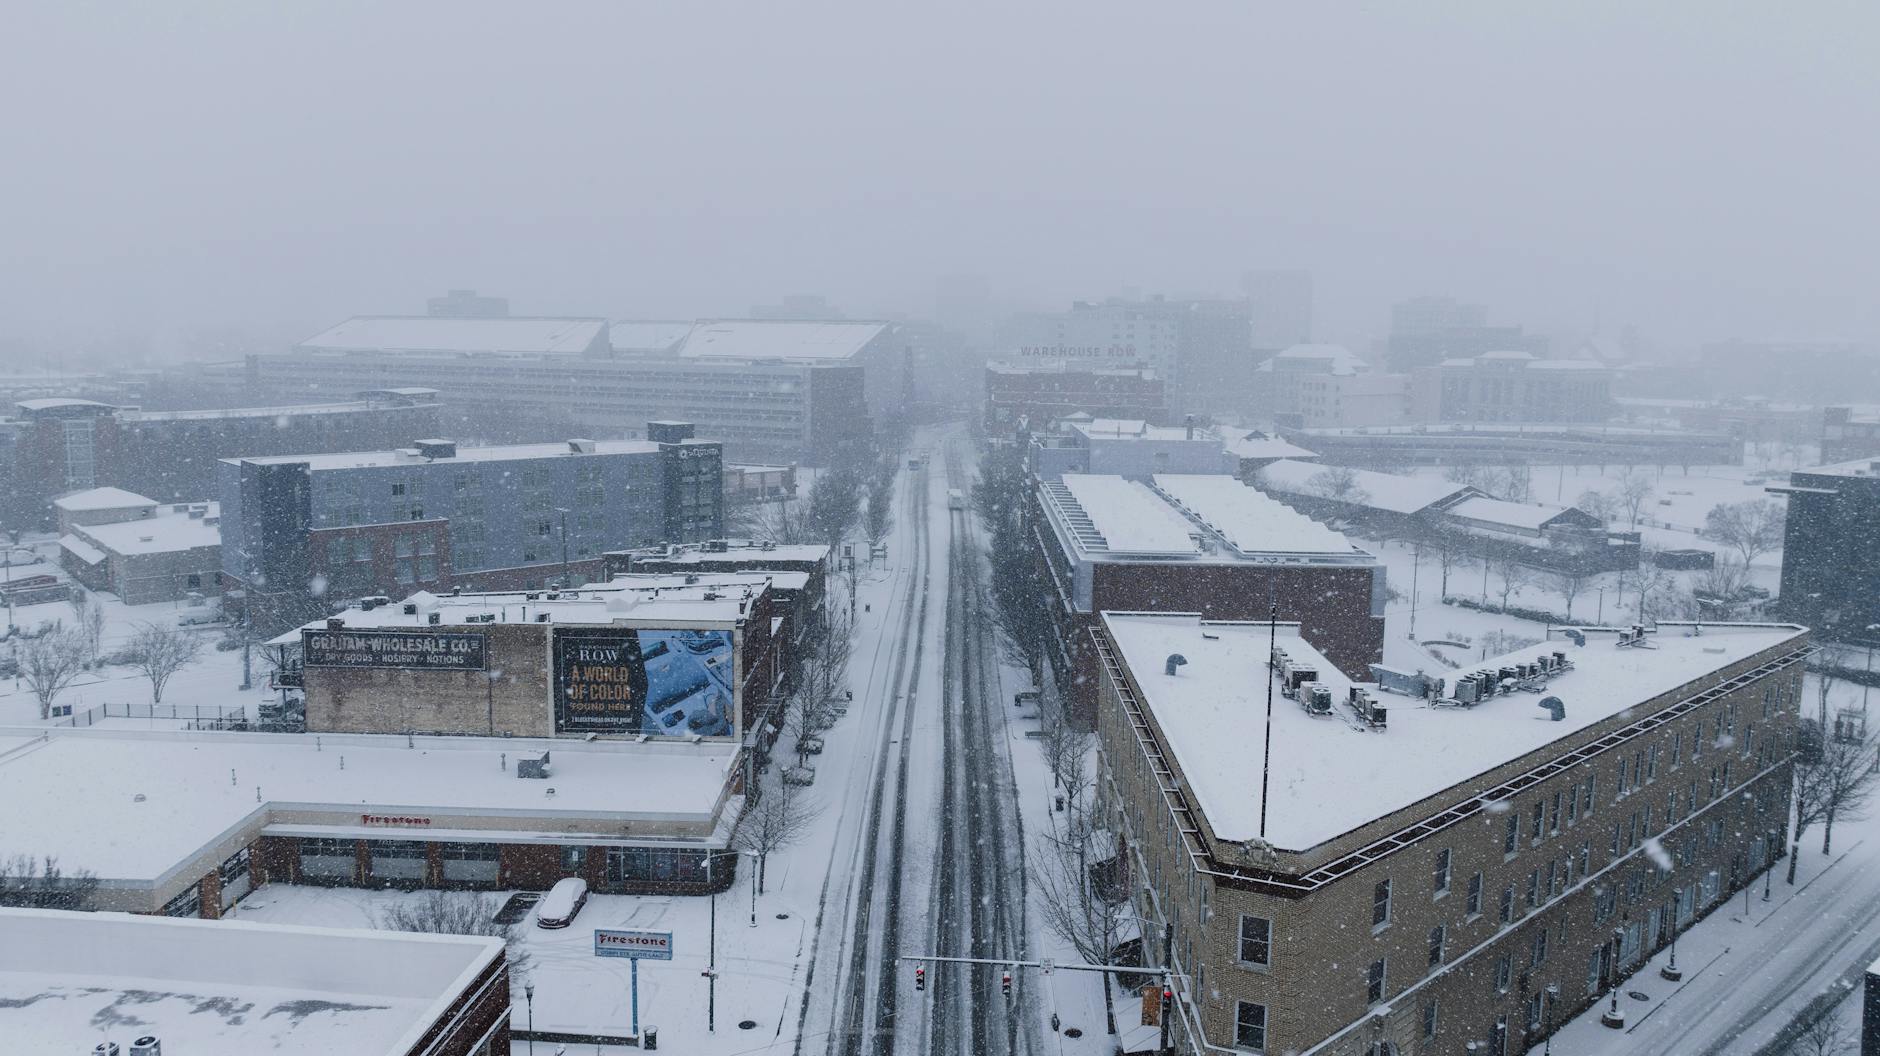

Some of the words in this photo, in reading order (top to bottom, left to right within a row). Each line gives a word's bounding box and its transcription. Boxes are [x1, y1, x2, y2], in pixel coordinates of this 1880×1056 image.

[1020, 345, 1101, 357] WAREHOUSE
[1107, 345, 1137, 357] ROW
[370, 637, 447, 653] WHOLESALE
[450, 639, 471, 653] CO.
[325, 652, 341, 661] DRY
[344, 653, 373, 663] GOODS
[382, 654, 418, 663] HOSIERY
[426, 655, 464, 664] NOTIONS
[580, 649, 618, 661] ROW
[571, 665, 580, 681] A
[583, 666, 629, 682] WORLD
[571, 684, 585, 700] OF
[589, 684, 631, 700] COLOR
[570, 702, 605, 711] FOUND
[608, 703, 631, 711] HERE
[362, 815, 431, 824] Firestone
[599, 933, 667, 946] Firestone
